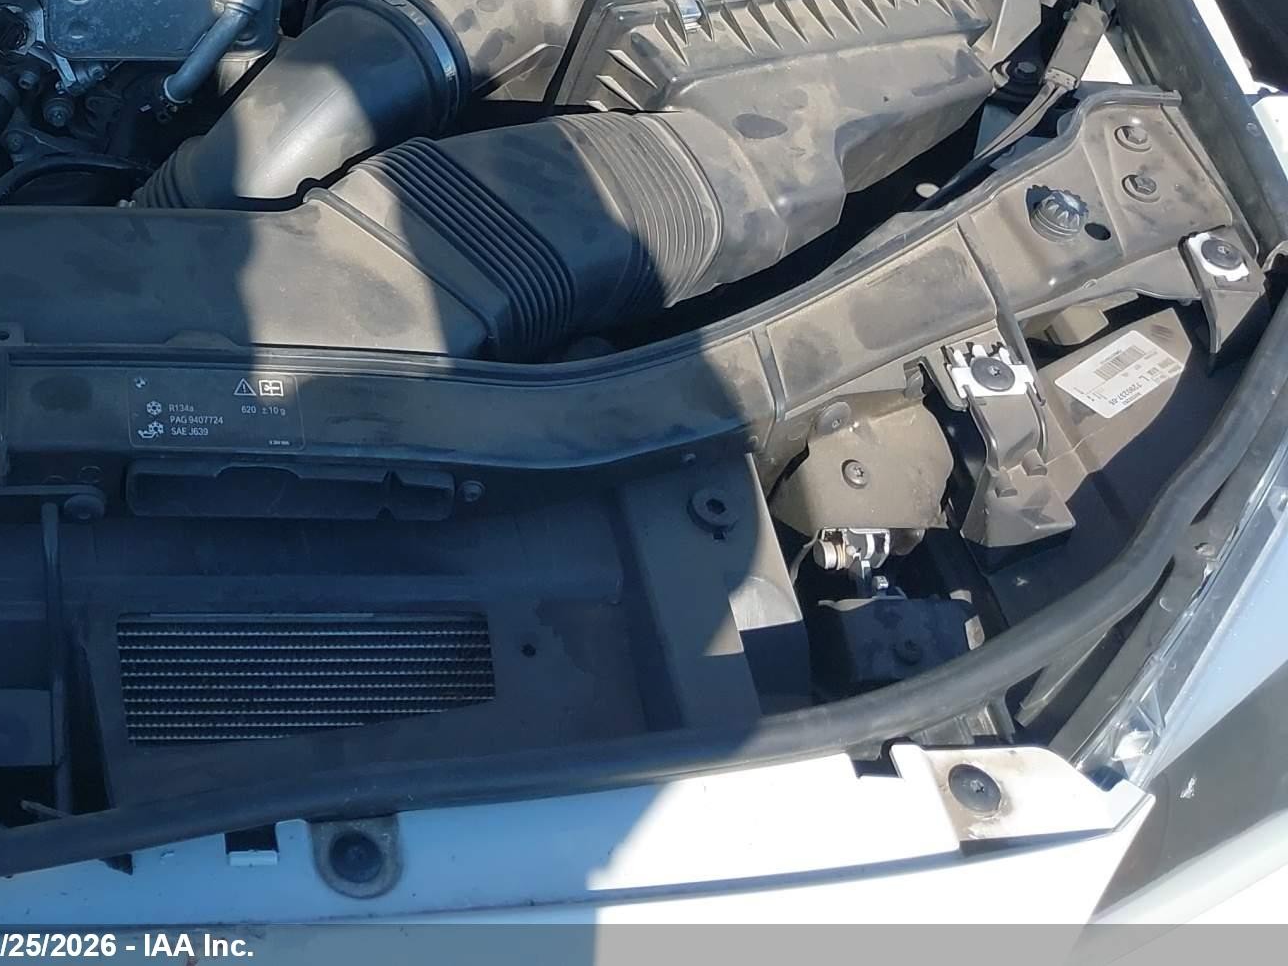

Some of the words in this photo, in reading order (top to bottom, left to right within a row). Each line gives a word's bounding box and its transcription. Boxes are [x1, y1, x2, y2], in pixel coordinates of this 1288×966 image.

[168, 403, 194, 413] R134a
[241, 405, 257, 415] 620
[170, 415, 188, 425] PAG
[189, 415, 224, 425] 9407724
[171, 427, 188, 436] SAE
[189, 427, 209, 436] J639
